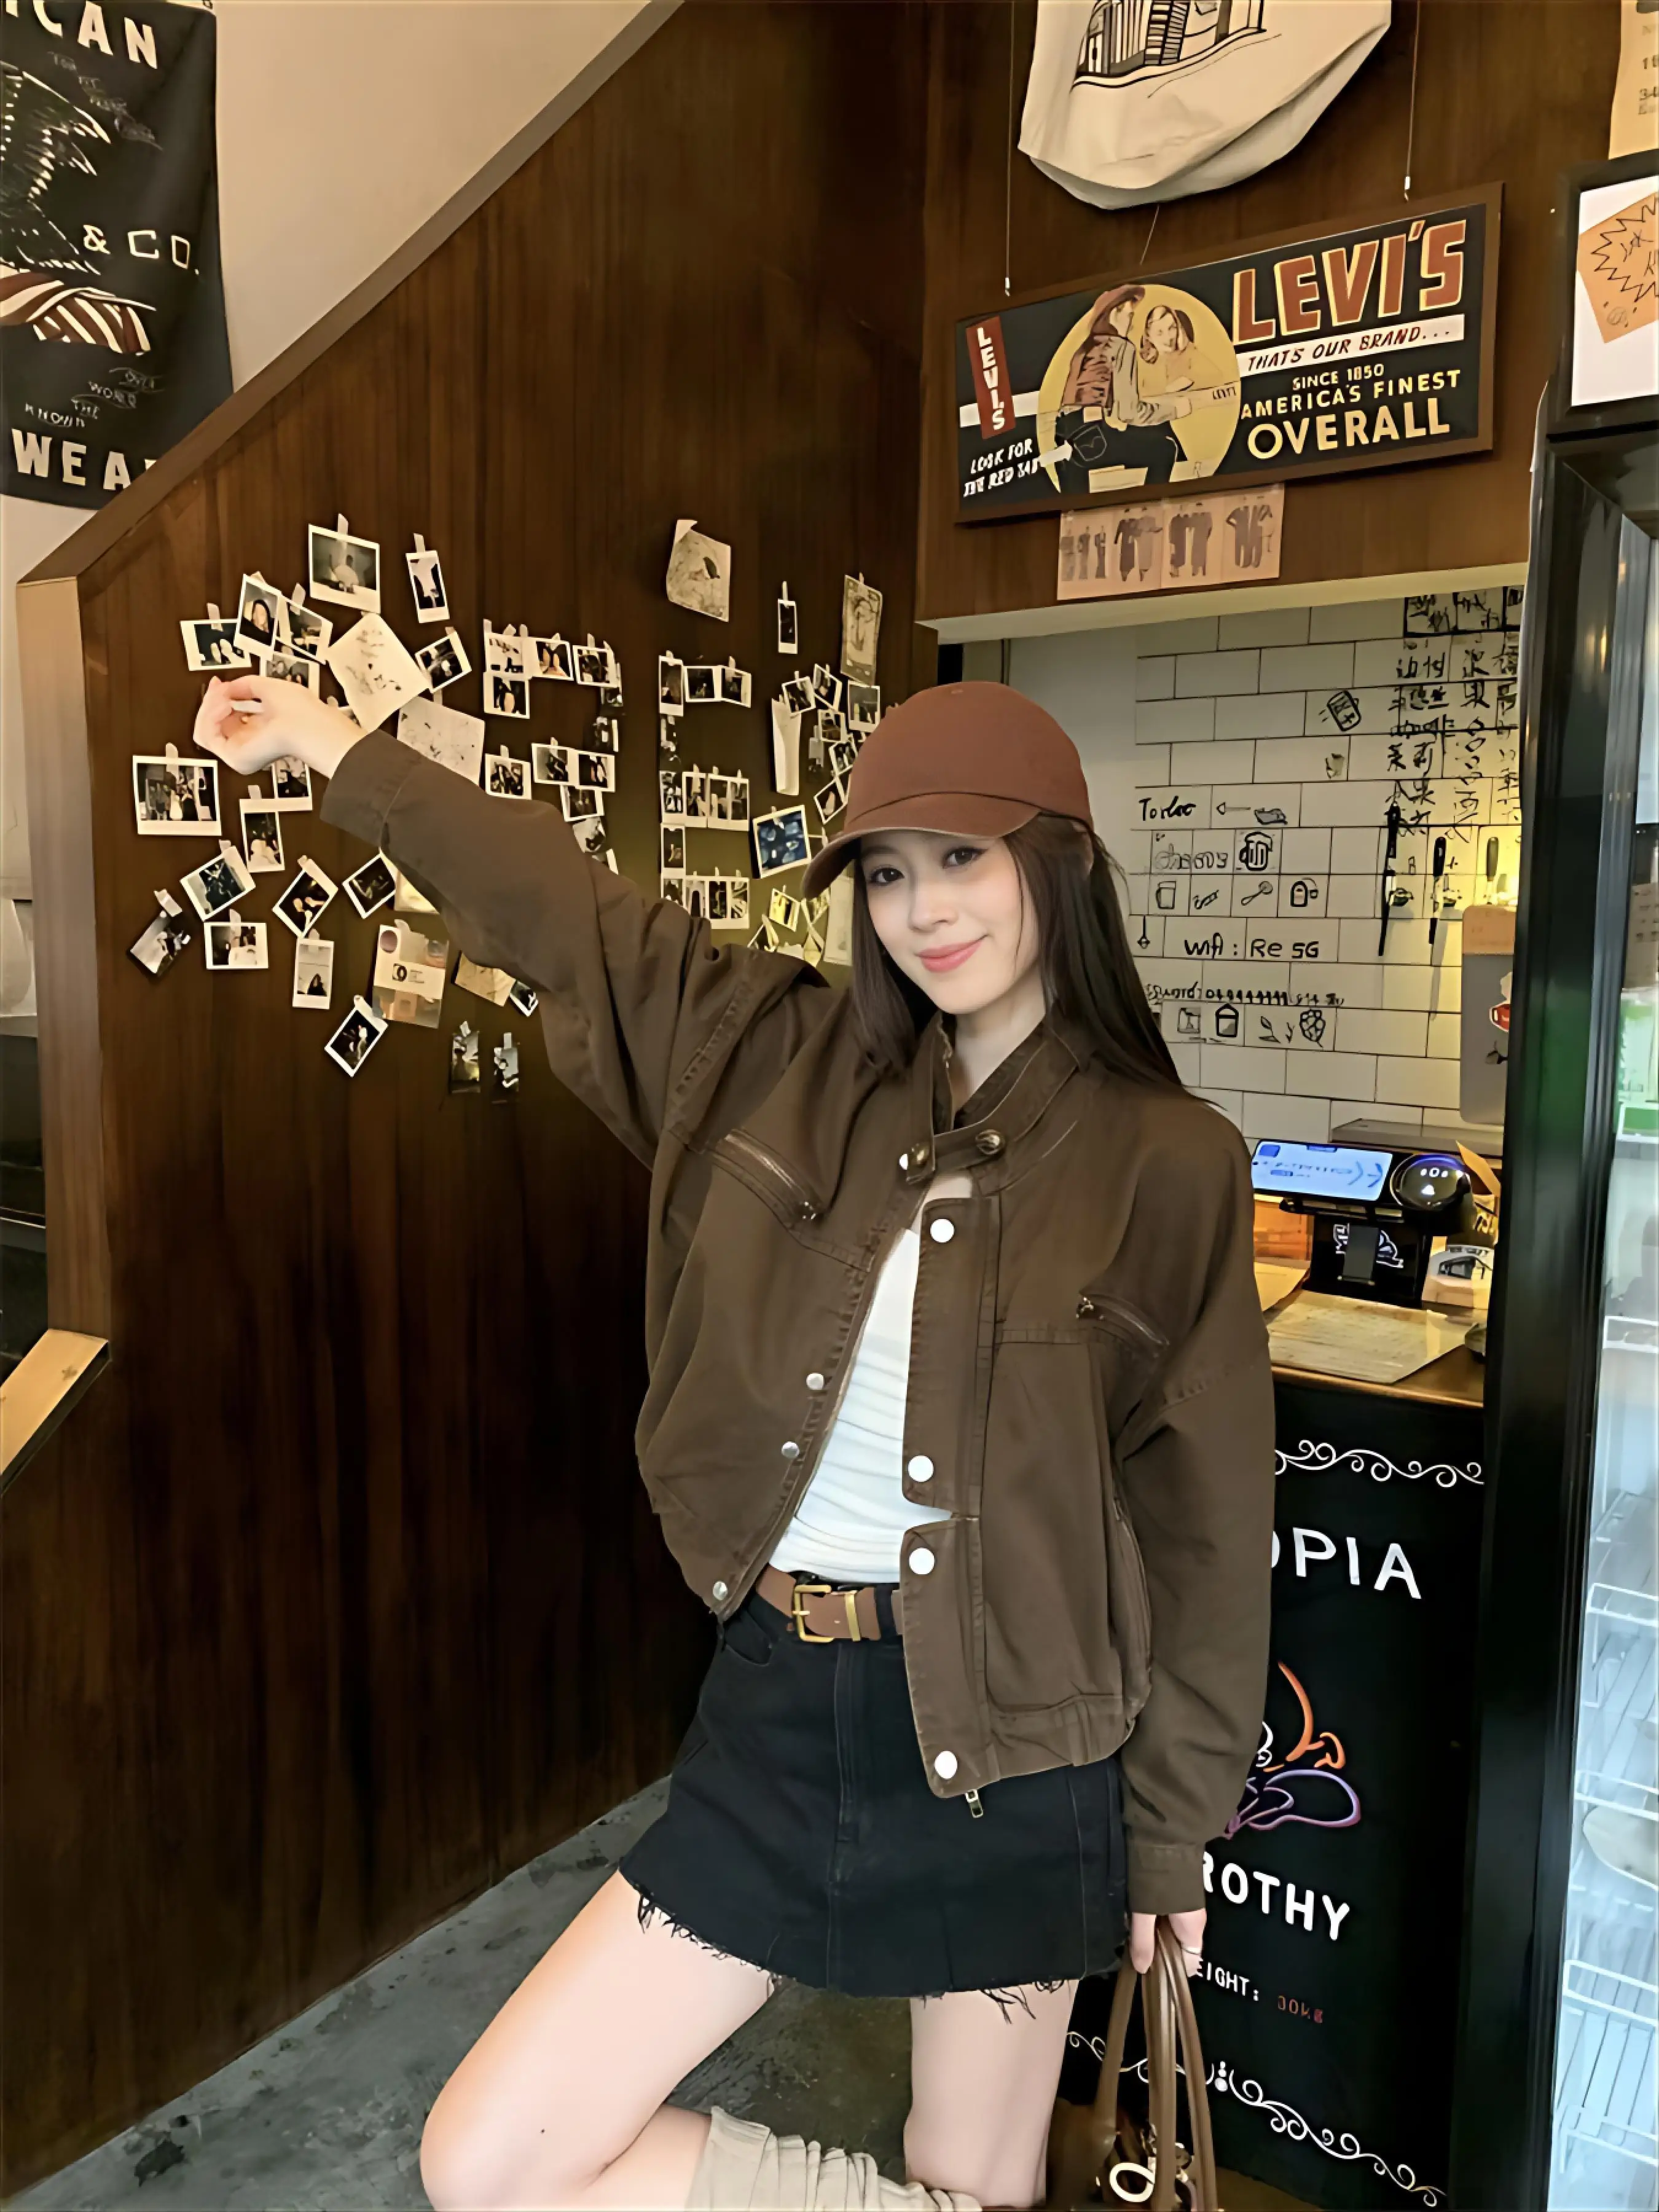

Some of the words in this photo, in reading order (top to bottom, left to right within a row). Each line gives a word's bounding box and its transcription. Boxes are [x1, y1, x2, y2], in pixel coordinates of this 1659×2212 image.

[84, 224, 111, 254] &
[128, 229, 200, 275] CO.
[1233, 219, 1467, 347] LEVI'S
[1312, 338, 1351, 359] OUR
[1241, 383, 1361, 419] AMERICA'S
[1373, 370, 1461, 399] FINEST
[1292, 371, 1338, 390] SINCE
[1347, 363, 1384, 382] 1850
[1247, 398, 1449, 460] OVERALL
[11, 428, 157, 490] WEA
[971, 449, 1004, 474] LOOK
[1008, 438, 1033, 460] FOR
